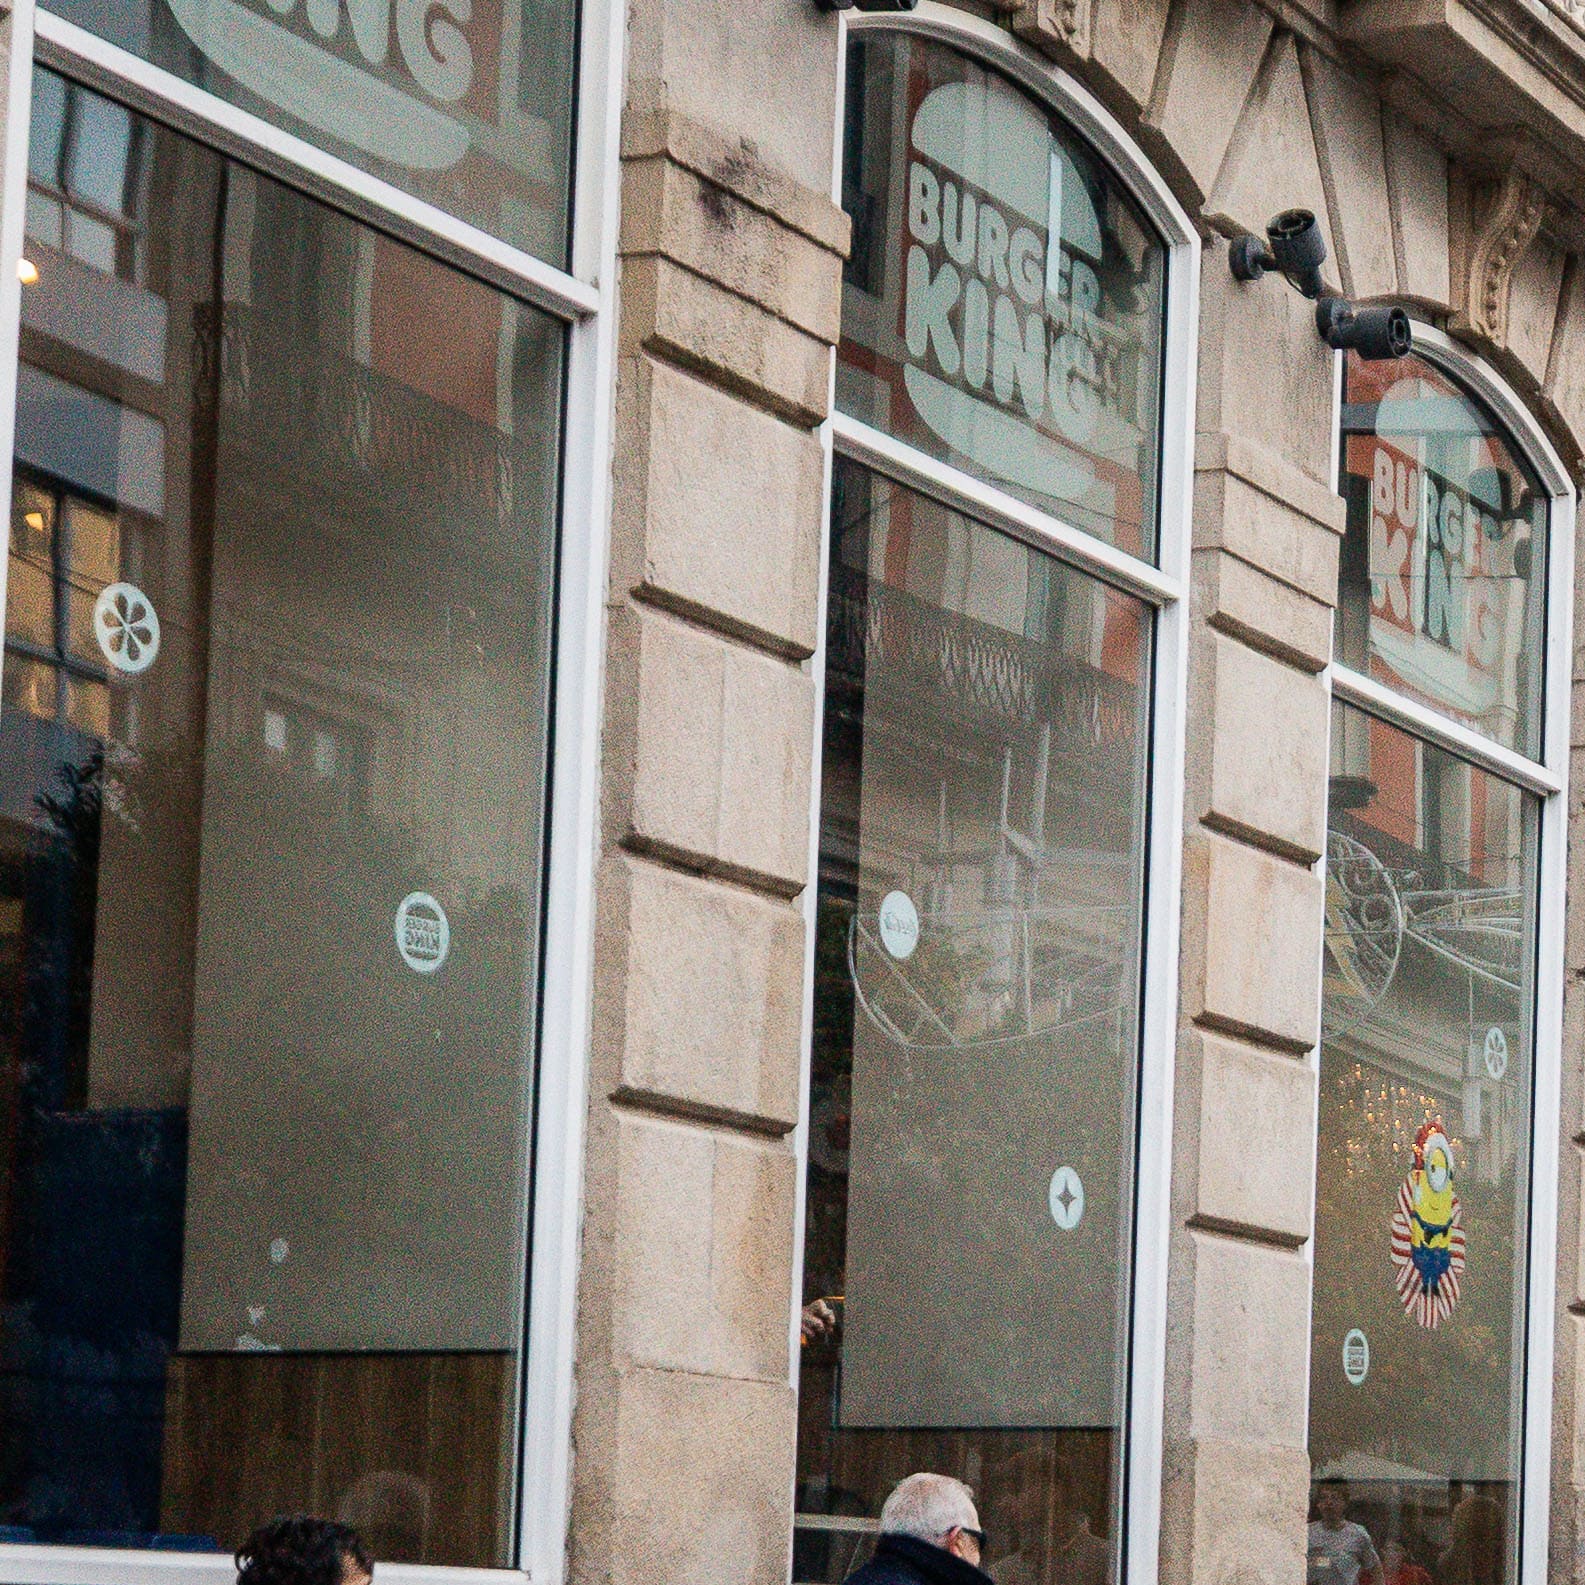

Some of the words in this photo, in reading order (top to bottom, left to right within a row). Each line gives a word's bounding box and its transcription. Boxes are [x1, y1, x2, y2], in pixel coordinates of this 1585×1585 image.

[909, 161, 1100, 343] BURGER
[905, 245, 1098, 443] KING
[1370, 516, 1503, 666] KING
